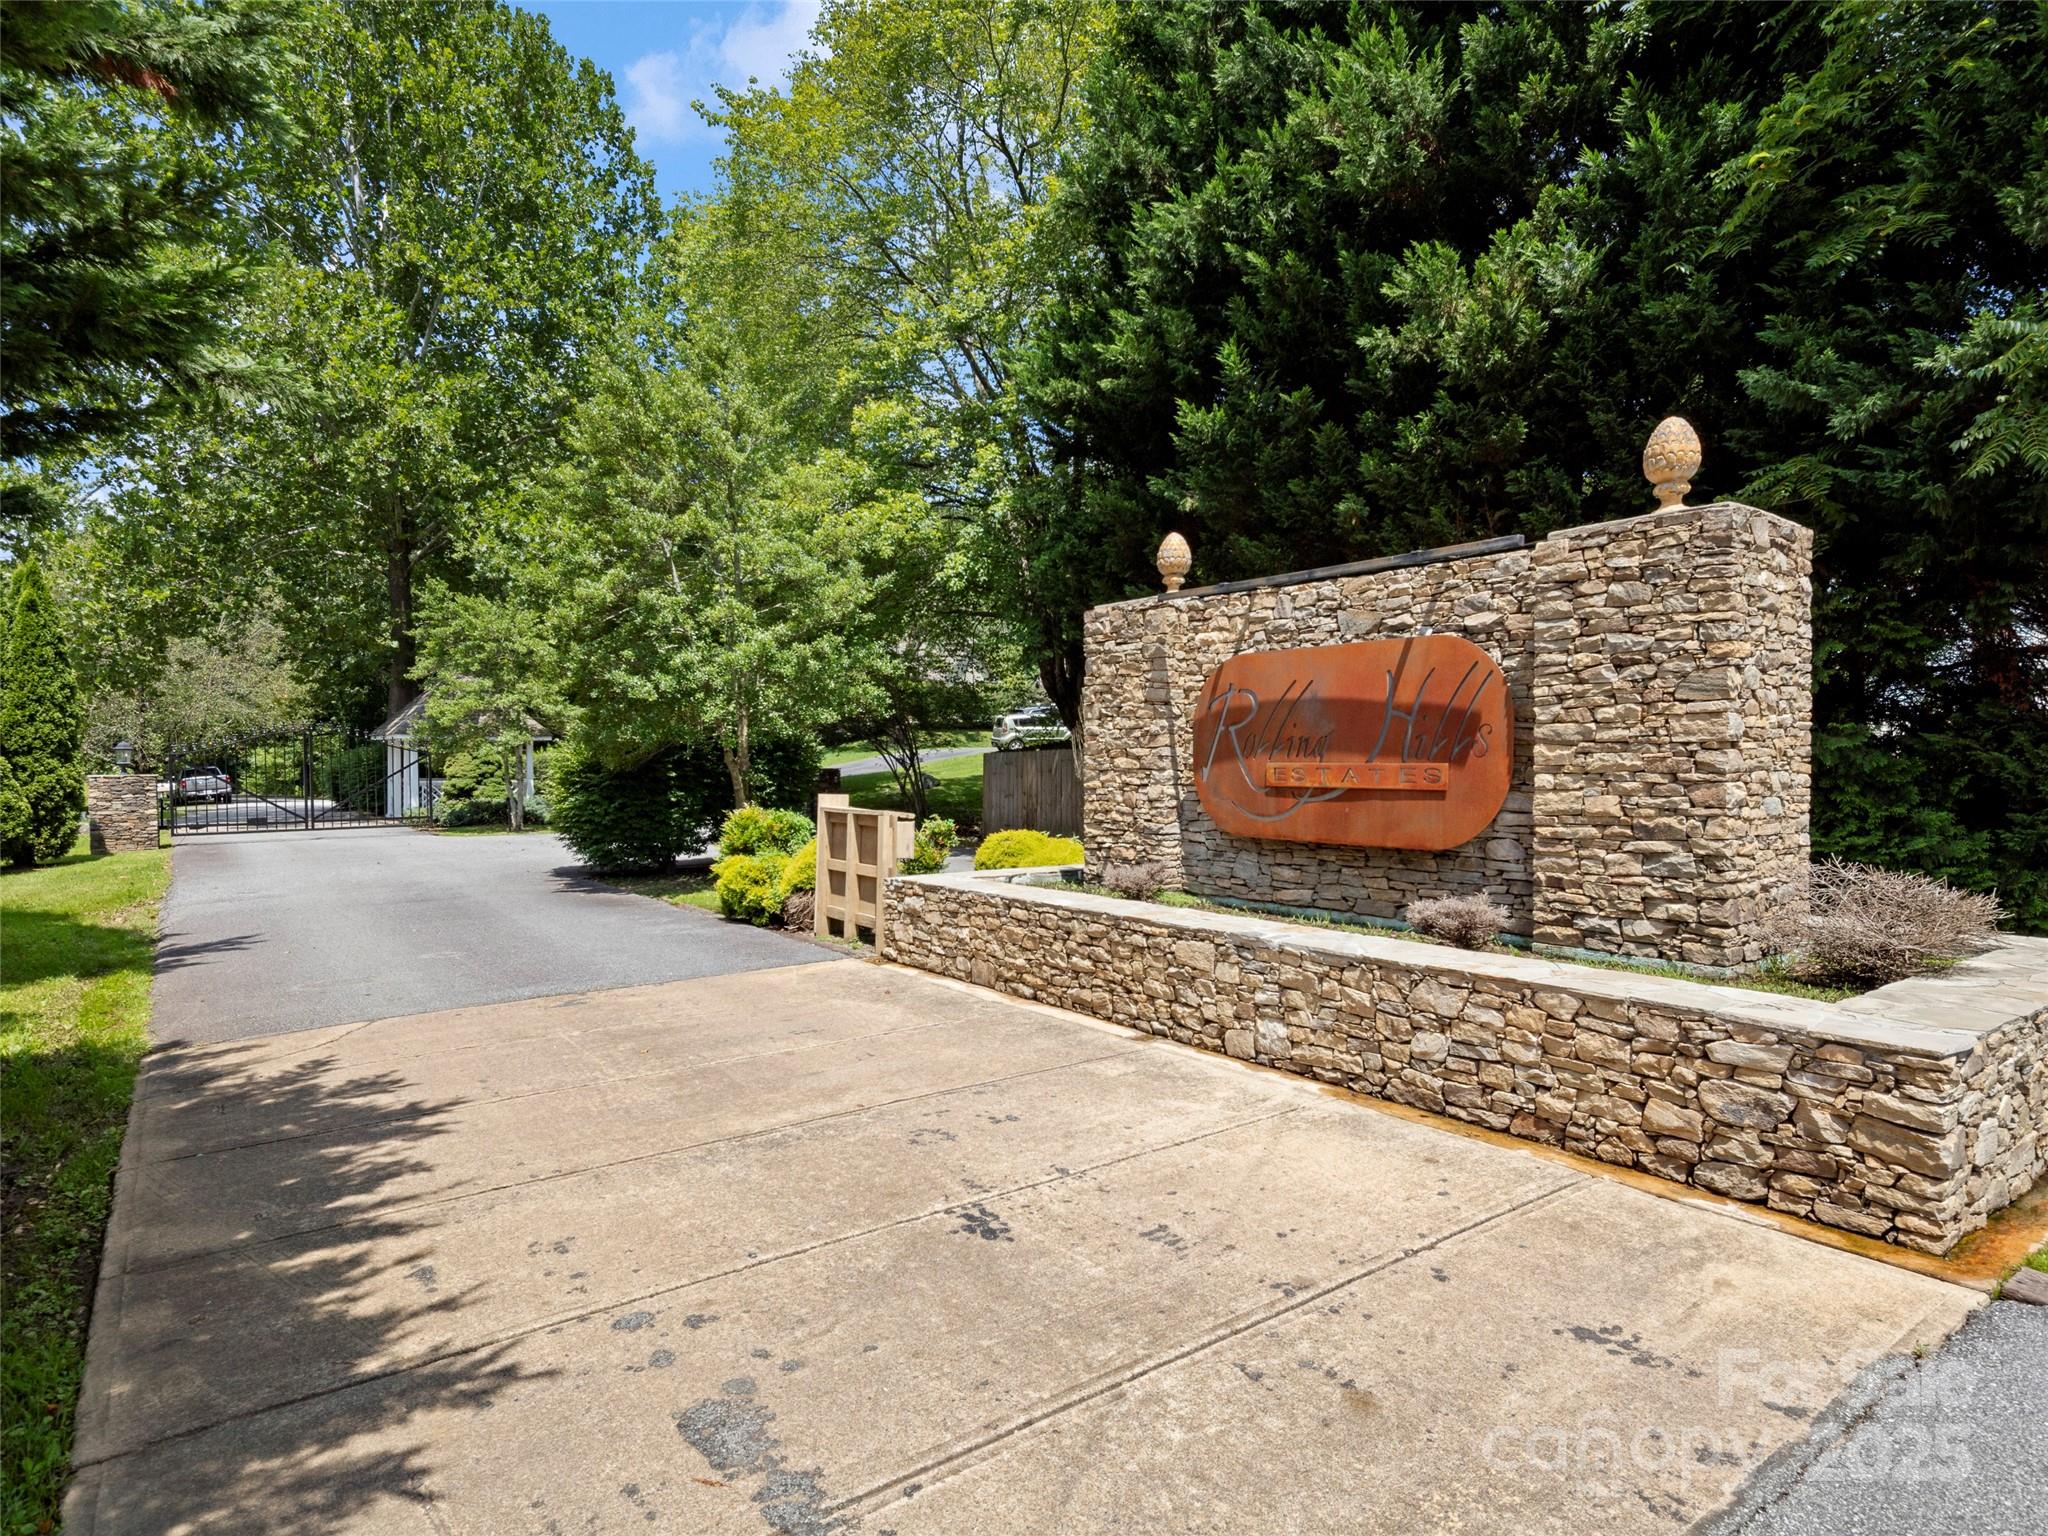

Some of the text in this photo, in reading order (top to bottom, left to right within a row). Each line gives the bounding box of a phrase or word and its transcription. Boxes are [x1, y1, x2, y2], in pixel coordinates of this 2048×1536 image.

[1201, 660, 1494, 821] Rolling Hills
[1272, 766, 1442, 786] ESTATES
